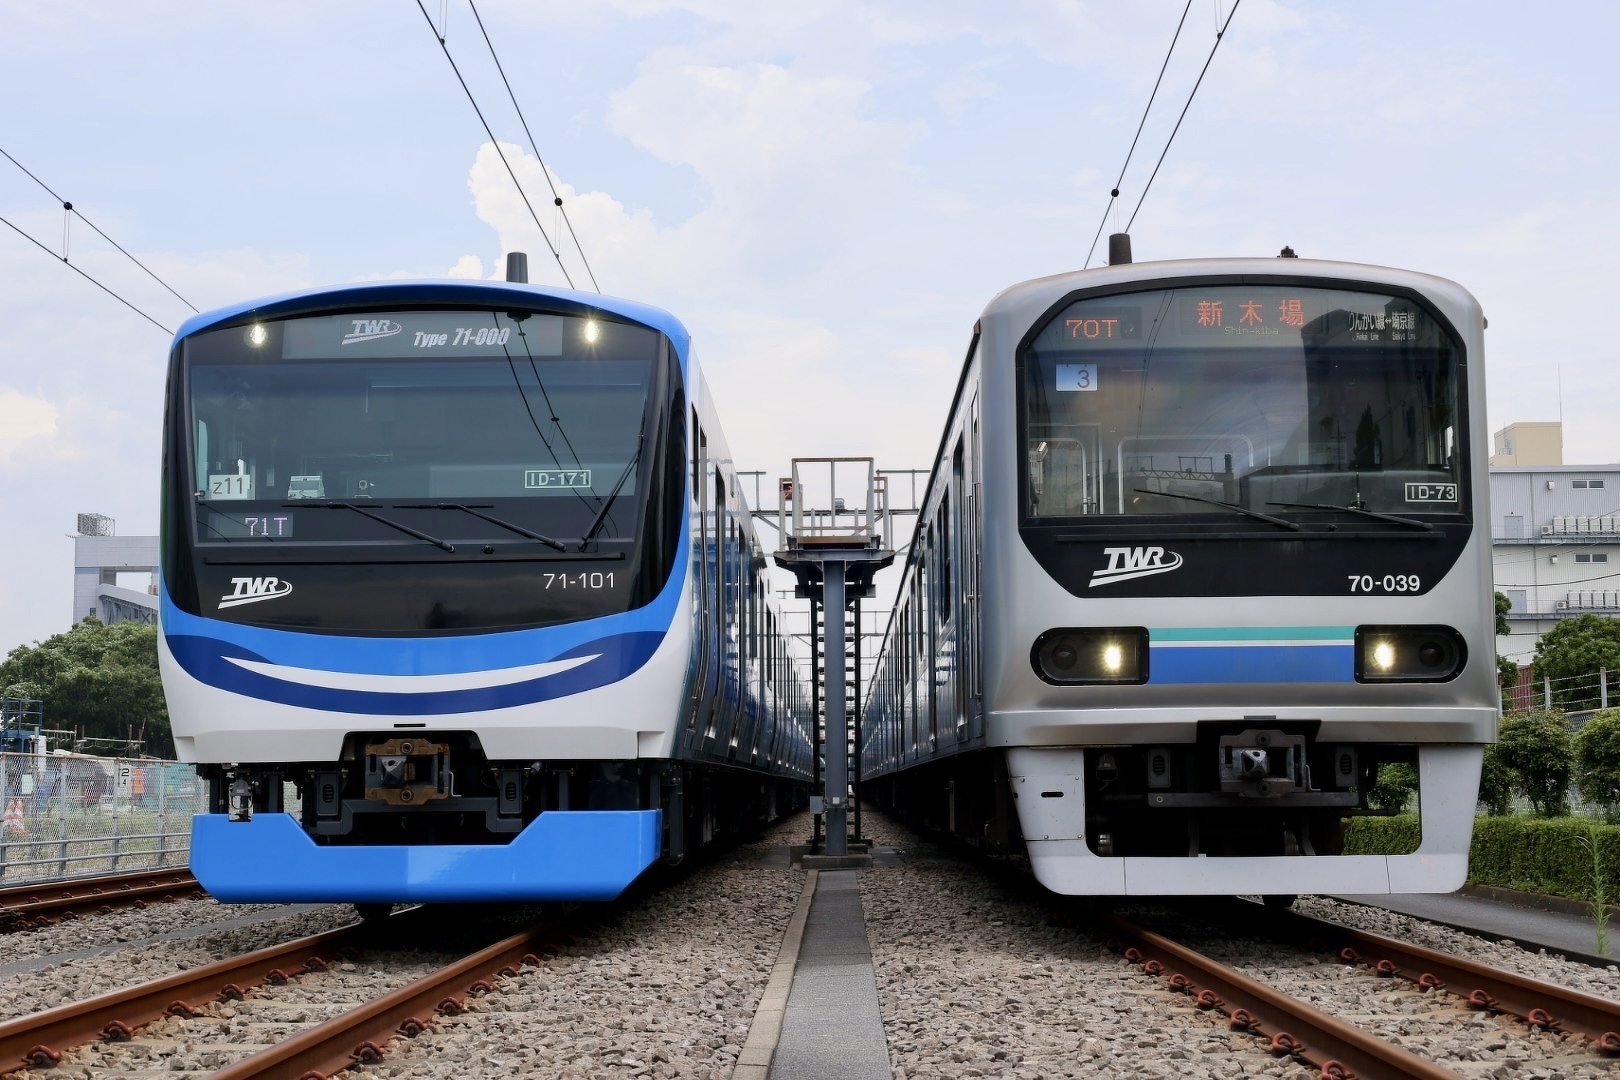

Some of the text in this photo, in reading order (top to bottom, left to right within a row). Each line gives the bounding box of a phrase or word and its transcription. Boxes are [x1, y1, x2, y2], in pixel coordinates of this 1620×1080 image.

[1198, 299, 1304, 326] 新木場
[1066, 319, 1118, 338] 70T
[414, 328, 511, 348] Type 71-000
[1077, 369, 1090, 389] 3
[530, 472, 588, 486] ID-171
[1411, 485, 1455, 500] ID-73
[245, 517, 288, 536] 71T
[543, 572, 614, 590] 71-101
[1348, 575, 1420, 592] 70-039
[121, 768, 130, 777] 2
